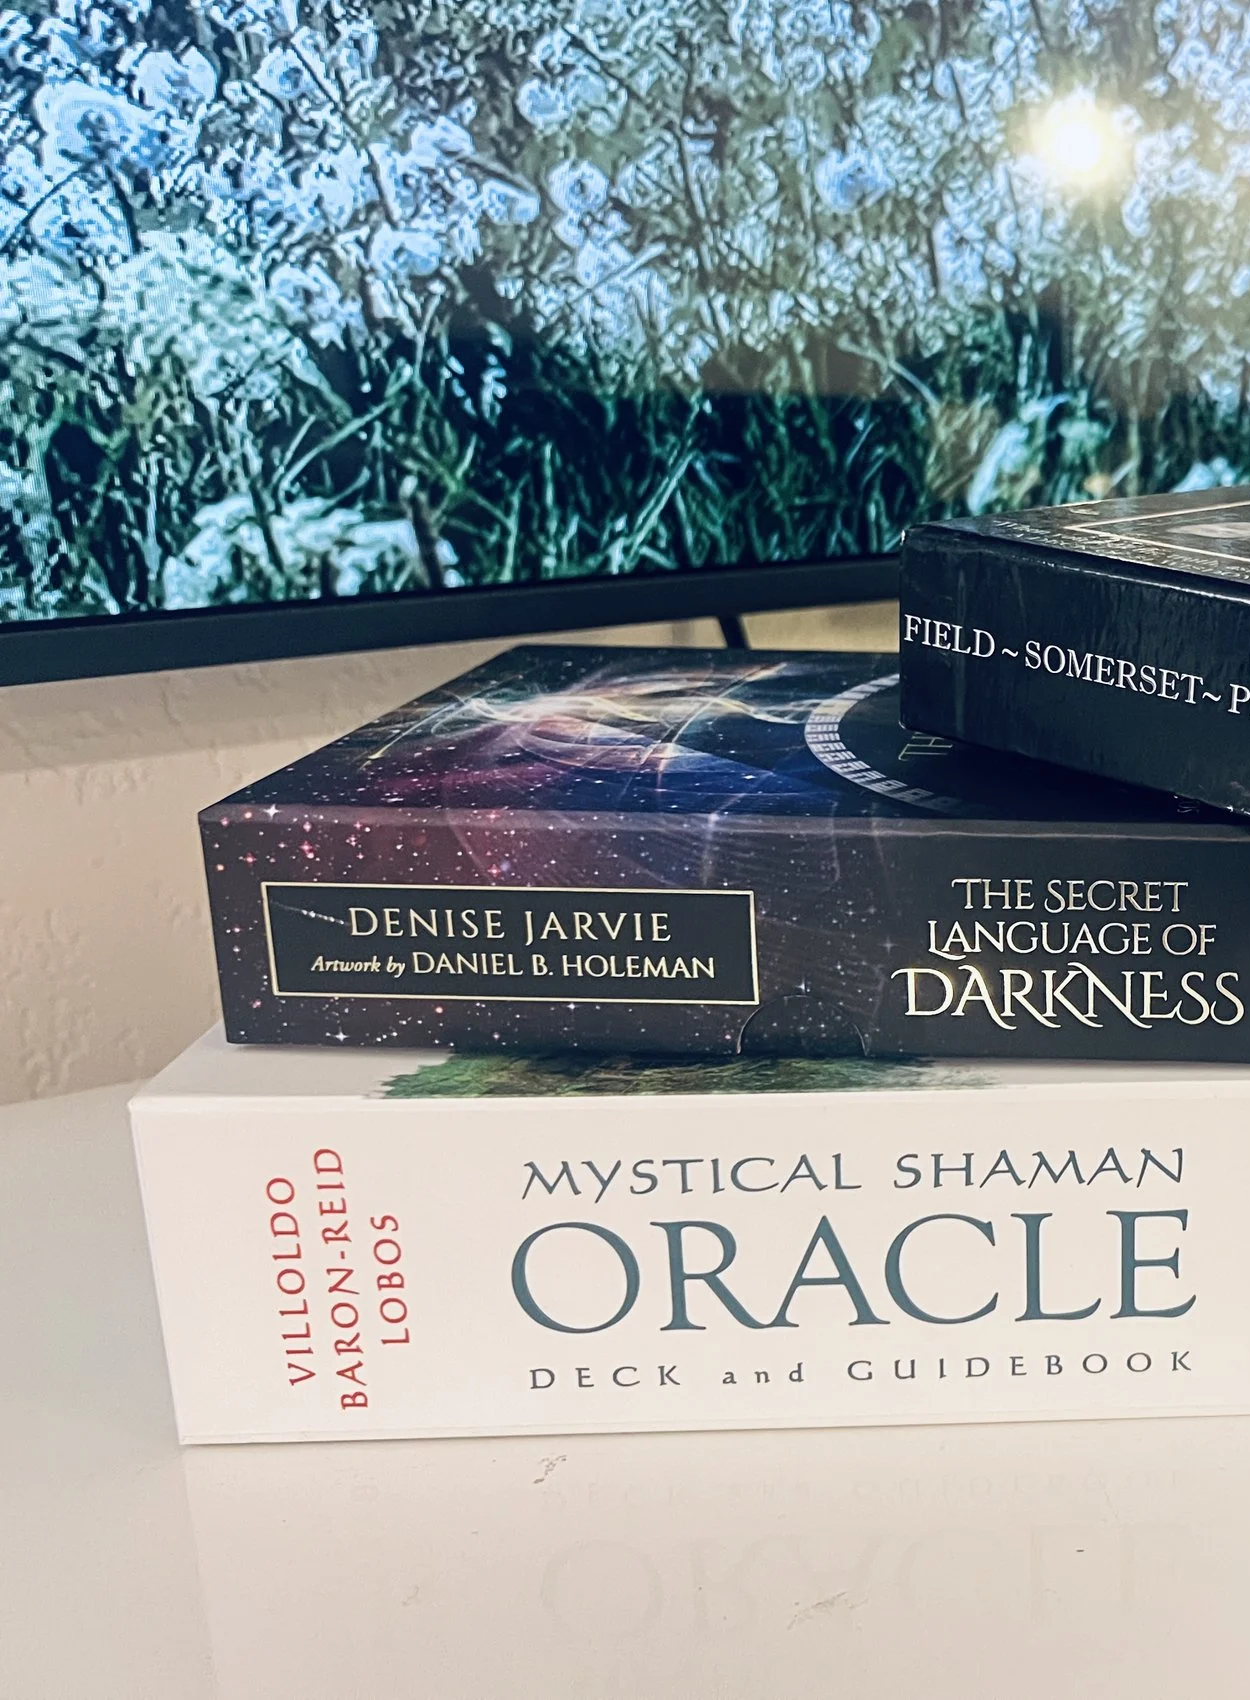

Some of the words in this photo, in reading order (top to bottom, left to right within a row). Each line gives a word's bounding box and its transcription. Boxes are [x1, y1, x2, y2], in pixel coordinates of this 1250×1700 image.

[904, 614, 995, 658] FIELD
[951, 878, 1035, 911] THE
[1043, 878, 1188, 914] SECRET
[348, 907, 505, 939] DENISE
[525, 910, 672, 946] JARVIE
[927, 919, 1153, 961] LANGUAGE
[1161, 922, 1217, 957] OF
[310, 955, 381, 973] Artwork
[386, 955, 406, 978] by
[412, 951, 524, 976] DANIEL
[531, 953, 554, 976] B.
[561, 954, 715, 979] HOLEMAN
[890, 961, 1246, 1031] DARKNESS
[521, 1152, 863, 1204] MYSTICAL
[893, 1147, 1185, 1191] SHAMAN
[265, 1175, 317, 1387] VILLOLDO
[313, 1147, 369, 1410] BARON-REID
[369, 1213, 411, 1346] LOBOS
[510, 1208, 1197, 1335] ORACLE
[529, 1364, 682, 1391] DECK
[721, 1361, 804, 1386] and
[846, 1349, 1192, 1382] GUIDEBOOK
